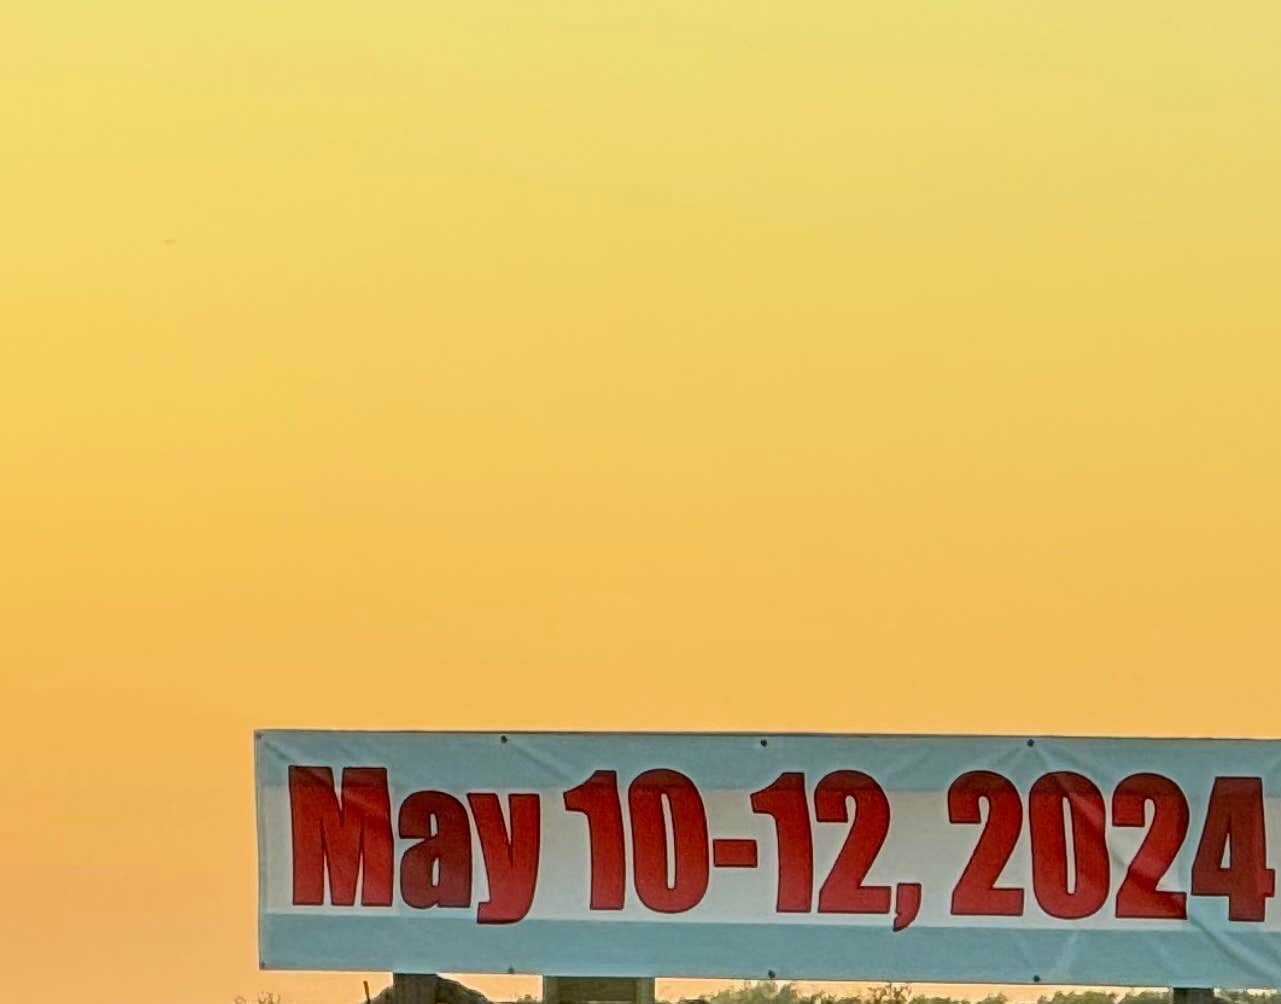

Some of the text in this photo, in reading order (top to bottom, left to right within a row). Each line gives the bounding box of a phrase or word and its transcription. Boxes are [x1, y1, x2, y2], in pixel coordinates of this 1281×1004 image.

[288, 765, 1276, 932] May 10-12, 2024
